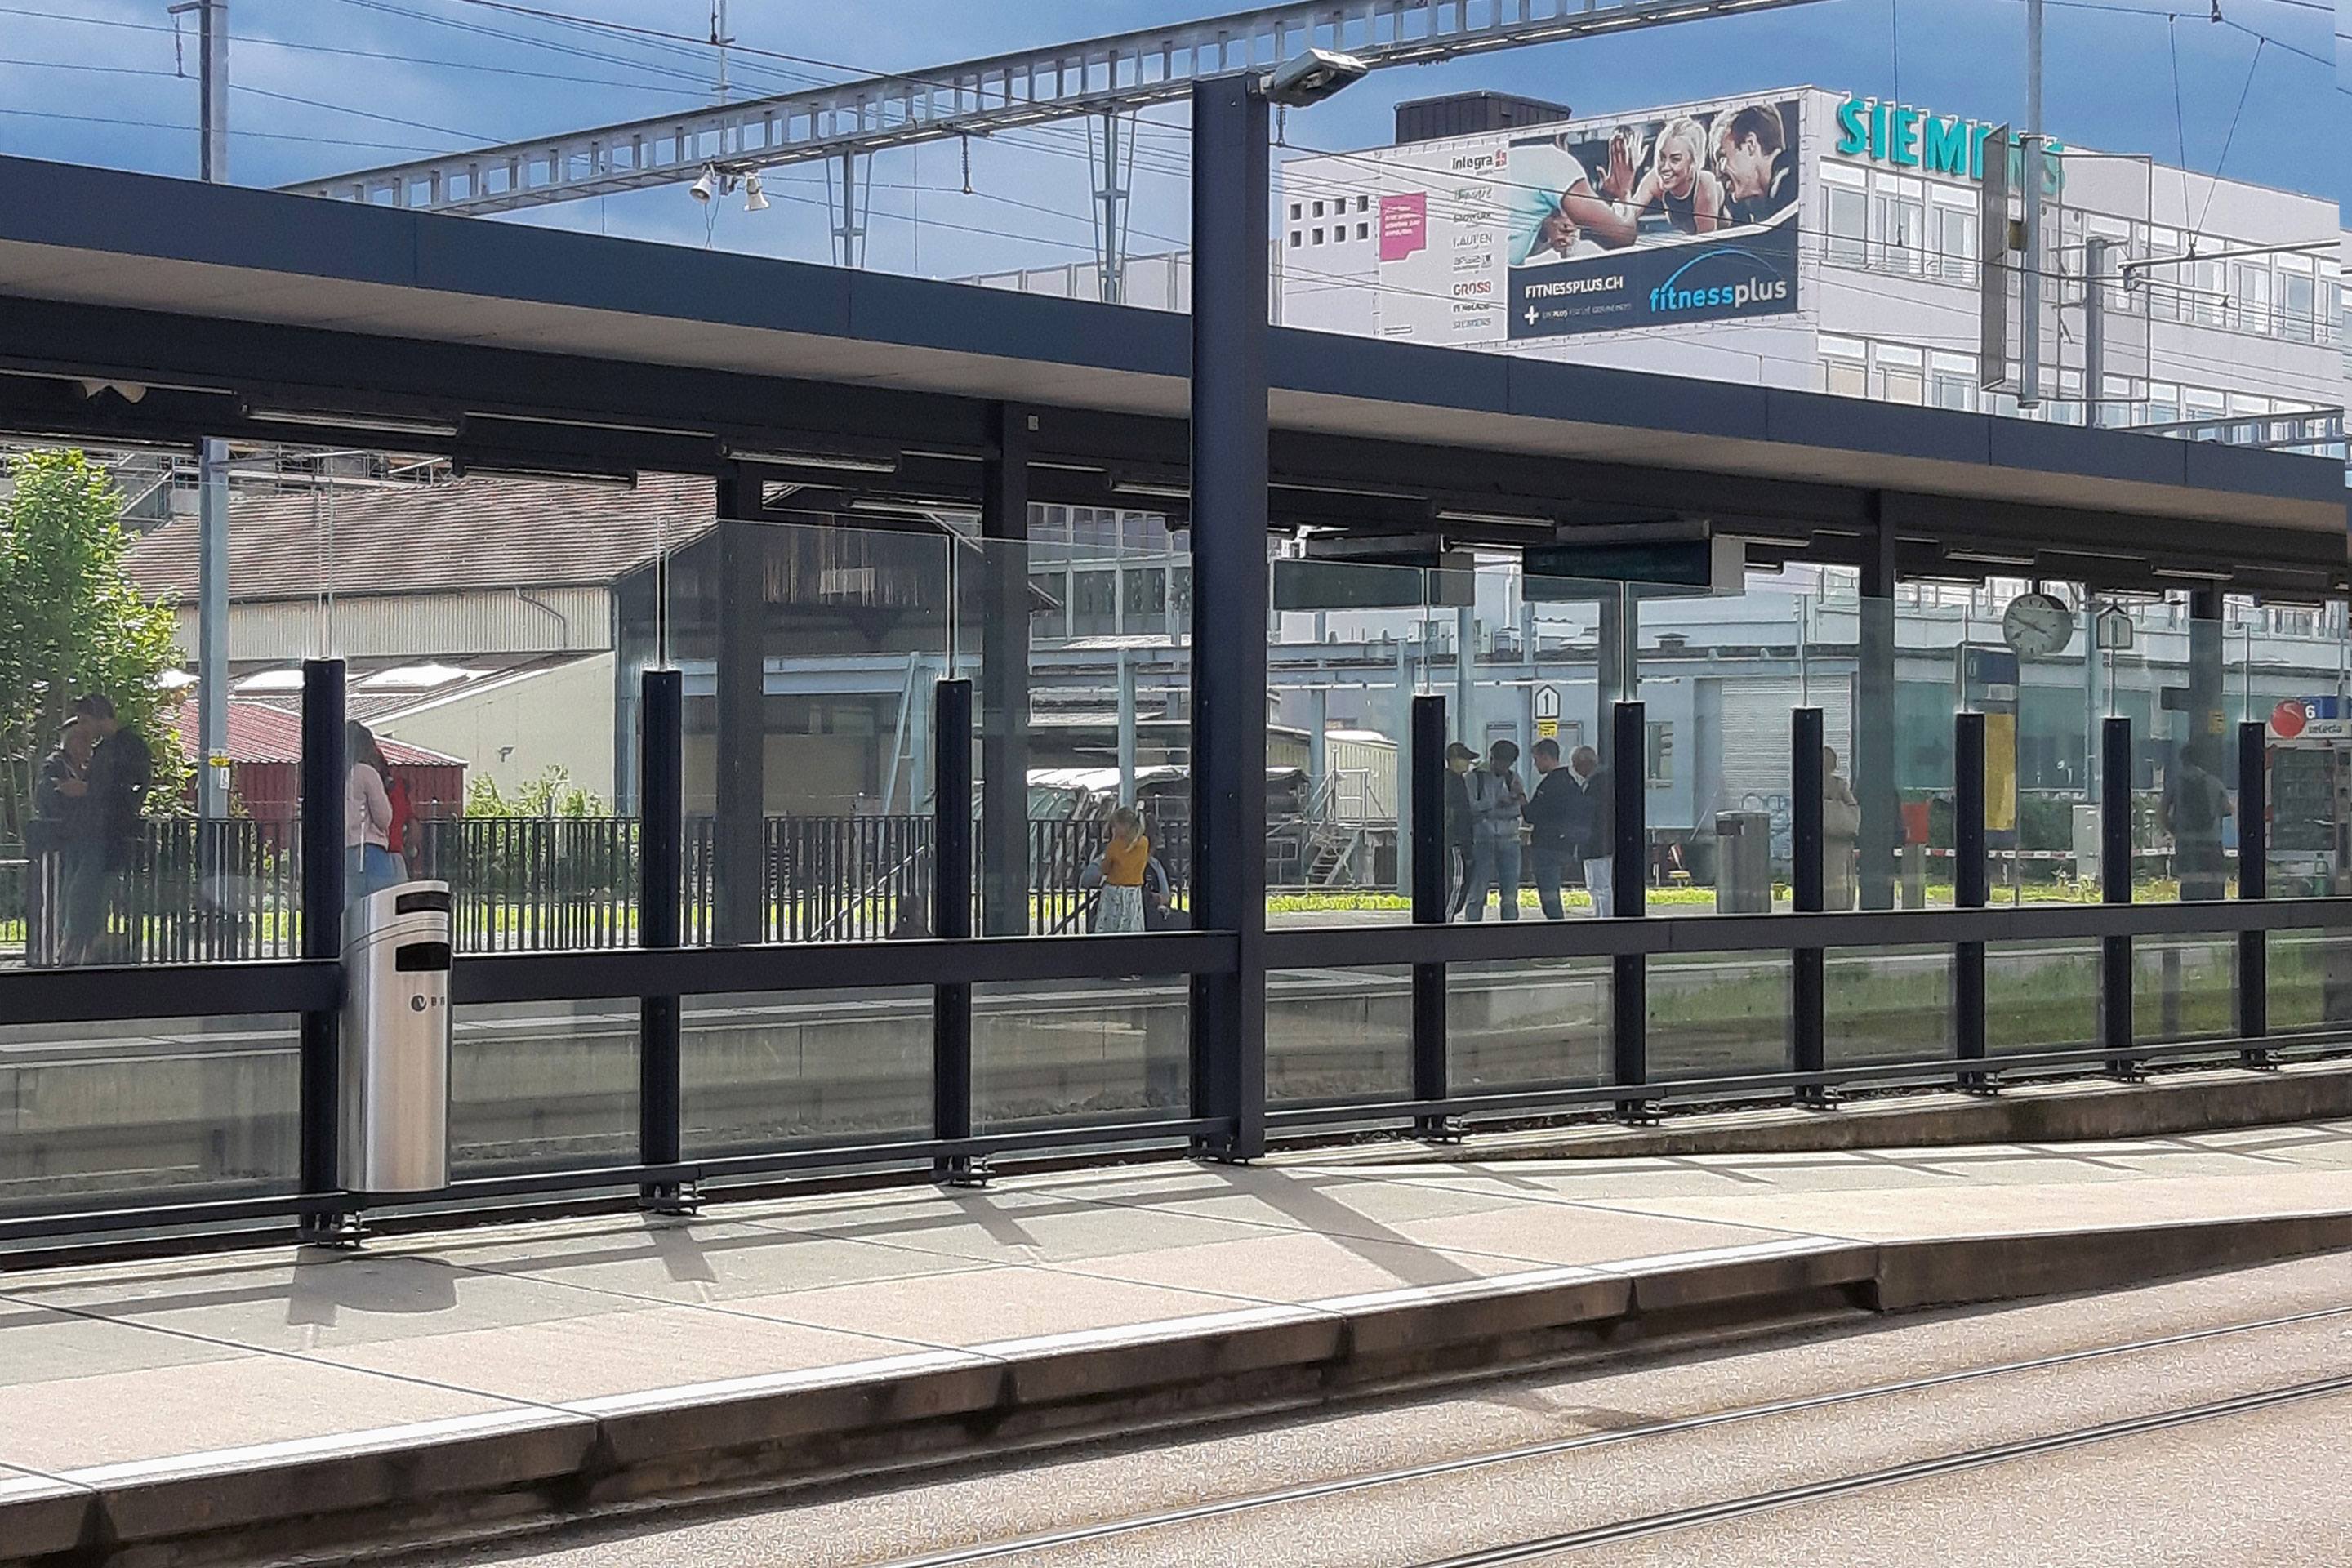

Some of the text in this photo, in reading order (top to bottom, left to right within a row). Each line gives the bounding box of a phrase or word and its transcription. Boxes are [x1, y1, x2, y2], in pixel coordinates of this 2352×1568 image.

[1453, 281, 1491, 295] GROSS
[1525, 275, 1624, 299] FITNESSPLUS.CH
[1650, 277, 1788, 312] fitnessplus
[1543, 693, 1549, 715] 1
[2305, 704, 2316, 719] 6
